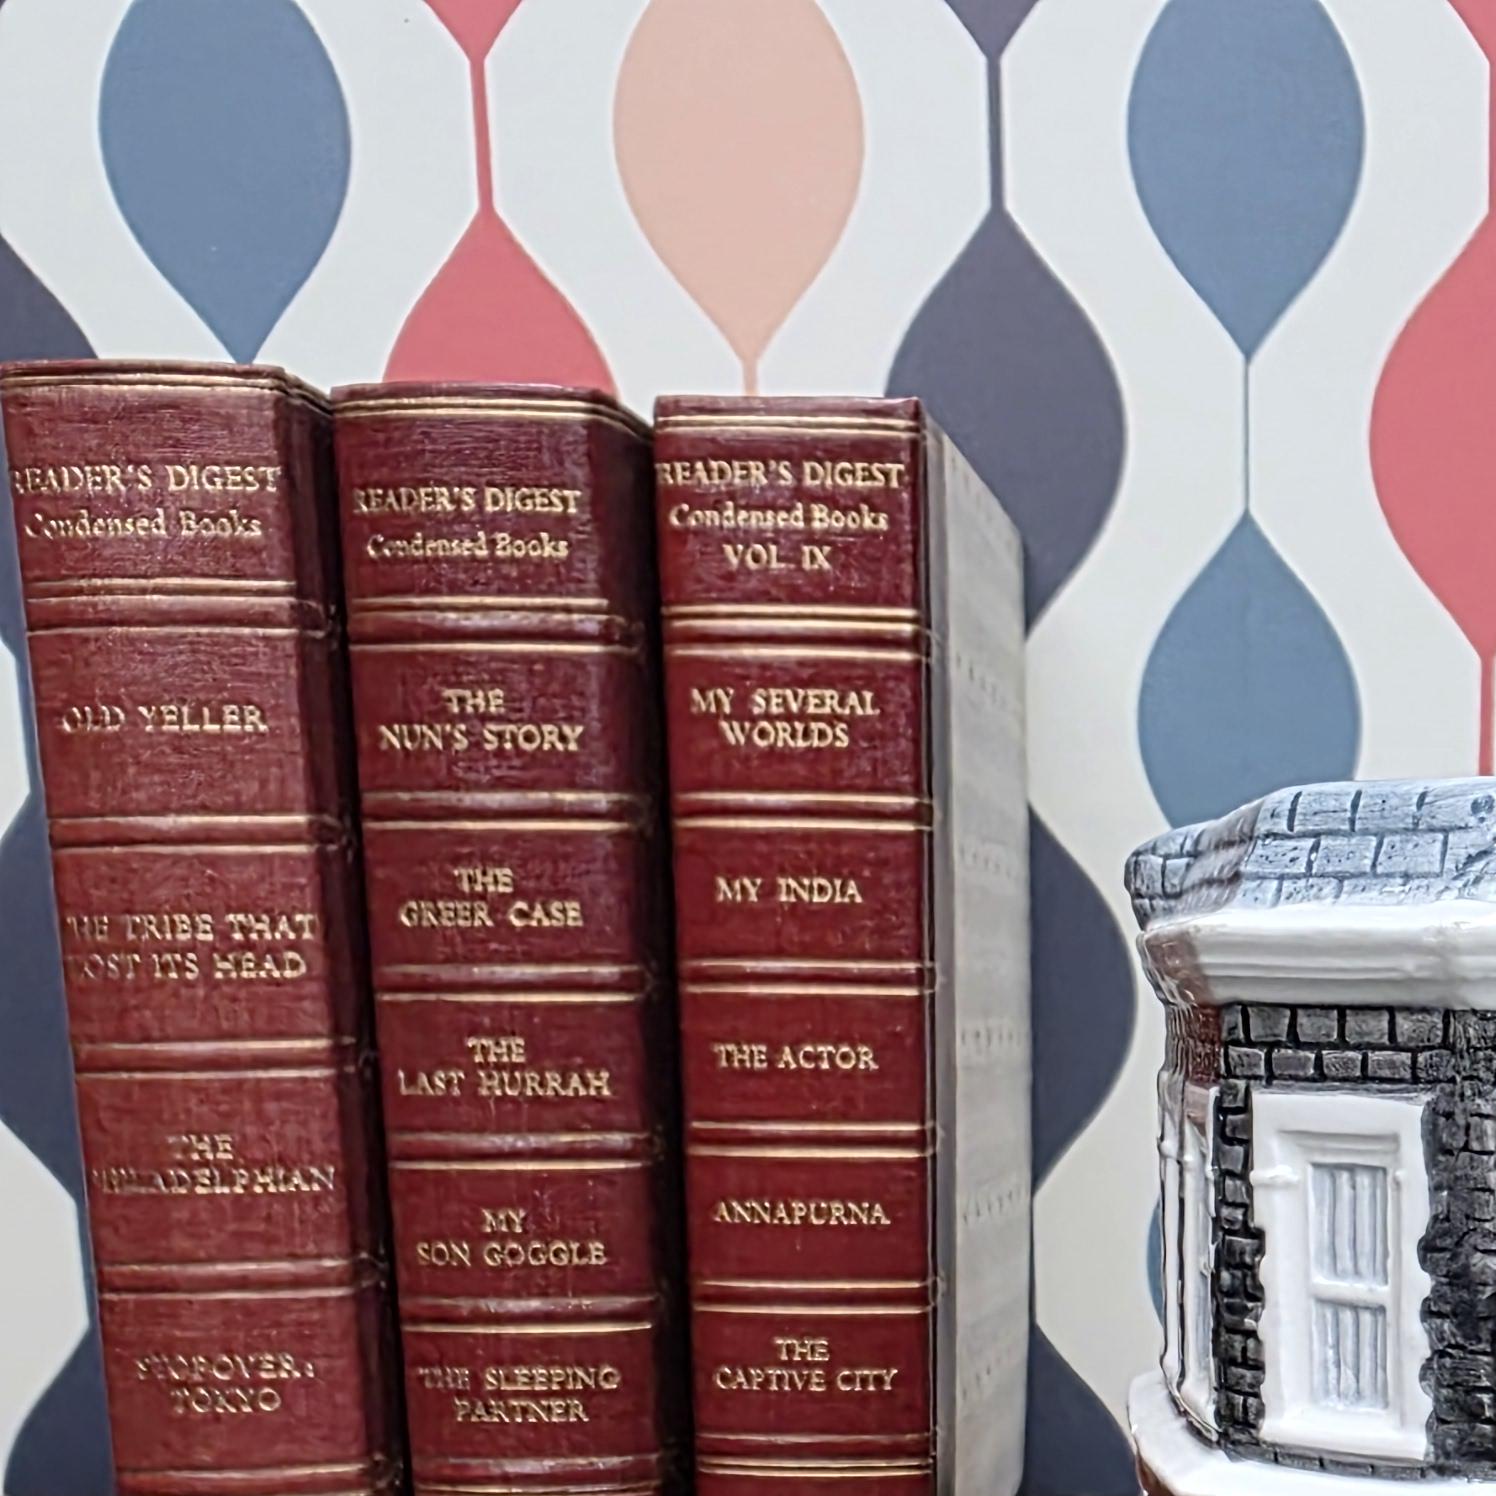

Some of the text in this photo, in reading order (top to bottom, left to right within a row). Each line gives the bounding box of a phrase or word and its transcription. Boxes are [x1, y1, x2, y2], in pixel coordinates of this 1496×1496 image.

[166, 465, 283, 493] DIGEST
[653, 459, 905, 489] READER'S DIGEST
[353, 485, 583, 514] READER'S DIGEST
[23, 507, 264, 540] Condensed Books
[668, 500, 890, 532] Condensed Books
[366, 530, 570, 560] Condensed Books
[801, 544, 833, 571] IX
[441, 687, 506, 715] THE
[690, 686, 881, 716] MY SEVERAL
[62, 704, 270, 734] OLD YELLER
[377, 723, 585, 752] NUN'S STORY
[718, 720, 850, 748] WORLDS
[452, 866, 516, 894] THE
[715, 875, 864, 904] MY INDIA
[122, 912, 215, 941] TRIBE
[224, 912, 319, 941] THAT
[399, 900, 585, 928] GREER CASE
[67, 950, 308, 981] OST ITS HEAD
[466, 1036, 527, 1064] THE
[712, 1042, 881, 1071] THE ACTOR
[397, 1068, 613, 1097] LAST HURRAH
[480, 1207, 528, 1234] MY
[713, 1200, 892, 1226] ANNAPURNA
[415, 1240, 608, 1267] SON GOGGLE
[771, 1336, 831, 1362] THE
[417, 1365, 622, 1391] THE SLEEPING
[714, 1366, 899, 1392] CAPTIVE CITY
[452, 1397, 591, 1423] PARTNER
